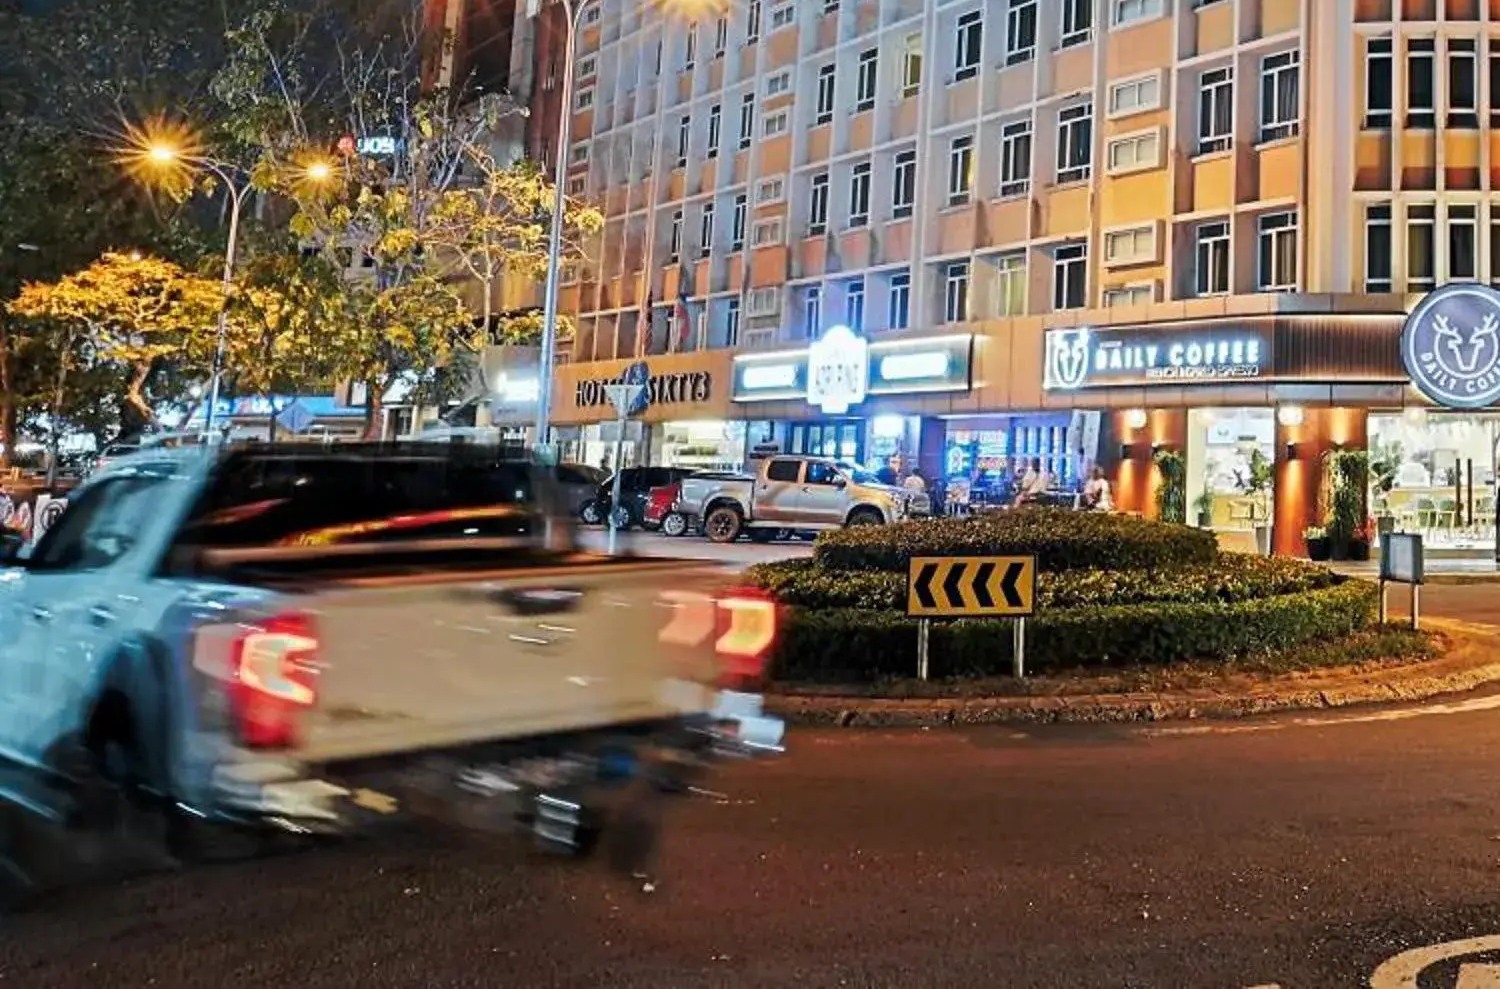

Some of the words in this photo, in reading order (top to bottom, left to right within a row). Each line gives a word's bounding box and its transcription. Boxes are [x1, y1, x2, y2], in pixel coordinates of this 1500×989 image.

[1095, 346, 1158, 370] DAILY
[1169, 340, 1259, 366] COFFEE
[1420, 351, 1457, 390] DAILY
[575, 378, 622, 407] HOT
